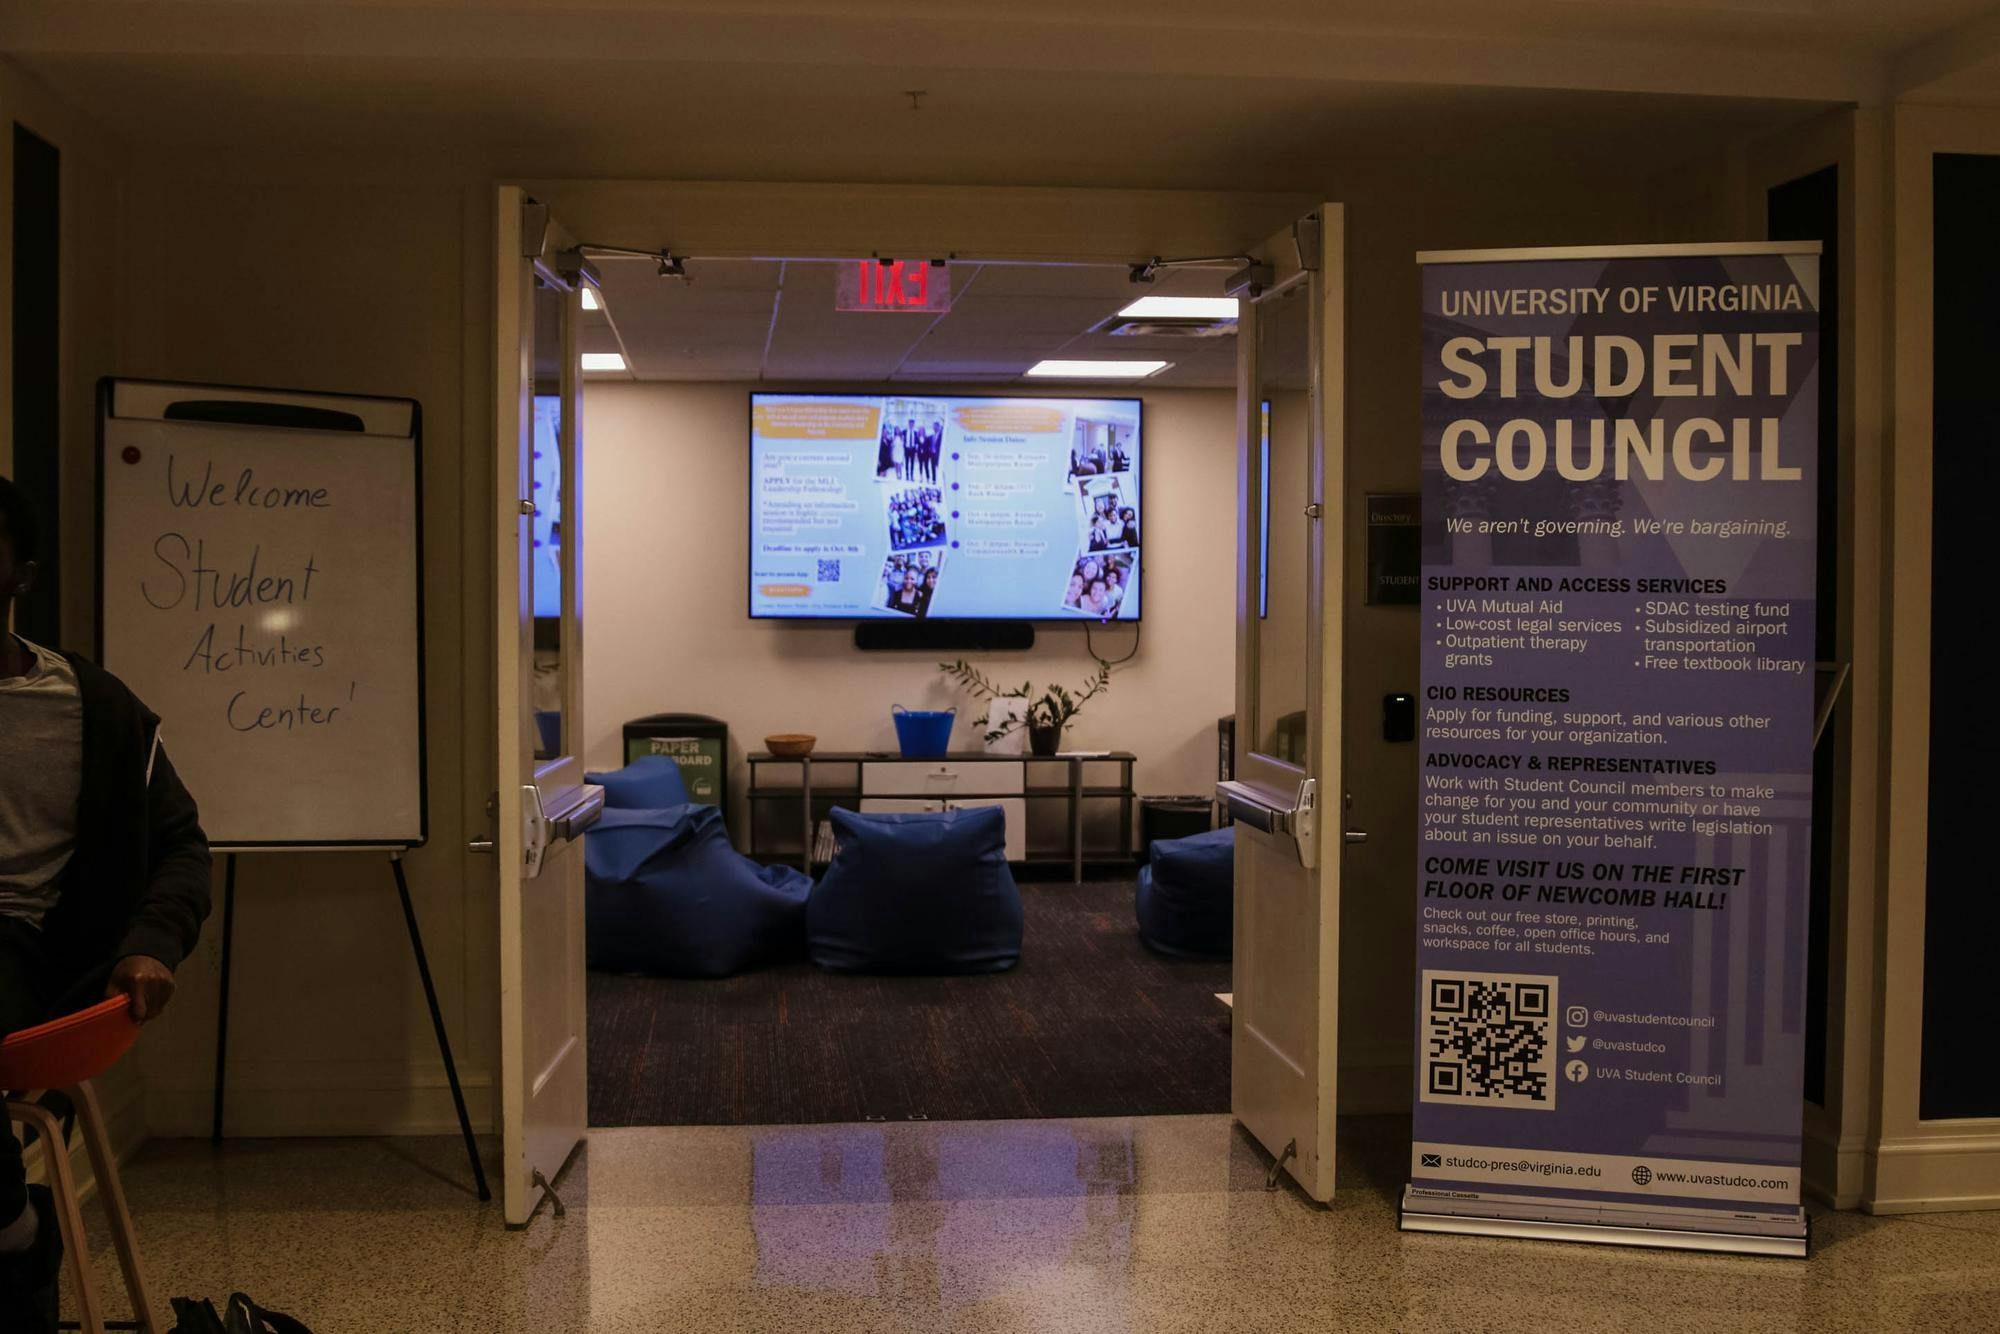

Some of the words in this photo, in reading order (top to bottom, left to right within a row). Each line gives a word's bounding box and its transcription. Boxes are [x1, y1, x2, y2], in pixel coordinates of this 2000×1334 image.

[1441, 287, 1610, 316] UNIVERSITY
[1619, 286, 1659, 313] OF
[1667, 283, 1804, 312] VIRGINIA
[1438, 333, 1802, 398] STUDENT
[1440, 417, 1801, 481] COUNCIL
[167, 453, 330, 507] Welcome
[1446, 517, 1473, 533] We
[1478, 518, 1530, 533] aren't
[1534, 518, 1625, 537] governing.
[1634, 518, 1683, 534] We're
[1690, 519, 1789, 538] bargaining.
[141, 532, 320, 611] Student
[1427, 576, 1510, 591] SUPPORT
[1515, 577, 1553, 592] AND
[1558, 577, 1630, 592] ACCESS
[1636, 578, 1726, 594] SERVICES
[1446, 599, 1476, 612] UVA
[1482, 599, 1533, 613] Mutual
[1538, 599, 1562, 613] Aid
[1645, 601, 1689, 615] SDAC
[1694, 602, 1749, 619] testing
[1754, 602, 1789, 616] fund
[1446, 617, 1511, 631] Low-cost
[1517, 617, 1552, 634] legal
[1558, 618, 1621, 632] services
[1645, 619, 1730, 634] Subsidized
[1736, 620, 1788, 637] airport
[184, 624, 325, 674] Activities
[1445, 634, 1525, 650] Outpatient
[1529, 635, 1587, 652] therapy
[1644, 638, 1755, 654] transportation
[1445, 653, 1493, 668] grants
[1645, 655, 1678, 669] Free
[1683, 656, 1751, 670] textbook
[1757, 657, 1805, 674] library
[1426, 685, 1456, 700] CIO
[1463, 686, 1569, 703] RESOURCES
[1426, 707, 1466, 724] Apply
[1471, 708, 1491, 721] for
[1496, 708, 1557, 726] funding,
[1563, 712, 1626, 726] support,
[1632, 712, 1661, 726] and
[1666, 712, 1723, 727] various
[1729, 714, 1771, 728] other
[1426, 727, 1500, 739] resources
[1505, 727, 1527, 740] for
[1531, 729, 1564, 743] your
[1569, 728, 1667, 745] organization.
[650, 741, 700, 754] PAPER
[672, 755, 713, 766] BOARD
[1425, 752, 1522, 769] ADVOCACY
[1527, 755, 1541, 770] &
[1547, 756, 1716, 775] REPRESENTATIVES
[1425, 775, 1463, 789] Work
[1467, 776, 1498, 790] with
[1504, 777, 1564, 792] Student
[1568, 779, 1625, 794] Council
[1631, 782, 1704, 797] members
[1709, 783, 1725, 797] to
[1731, 784, 1774, 799] make
[1425, 792, 1479, 810] change
[1484, 794, 1505, 808] for
[1509, 798, 1535, 811] you
[1541, 797, 1569, 810] and
[1574, 800, 1608, 813] your
[1612, 800, 1697, 817] community
[1702, 804, 1718, 815] or
[1723, 802, 1760, 816] have
[1424, 812, 1456, 826] your
[1462, 811, 1519, 826] student
[1524, 816, 1643, 830] representatives
[1649, 818, 1686, 832] write
[1692, 819, 1772, 835] legislation
[1424, 827, 1467, 842] about
[1472, 831, 1491, 842] an
[1496, 829, 1537, 844] issue
[1542, 834, 1561, 845] on
[1566, 835, 1599, 848] your
[1604, 833, 1656, 848] behalf.
[1424, 856, 1490, 876] COME
[1496, 859, 1550, 878] VISIT
[1556, 861, 1584, 880] US
[1592, 863, 1624, 881] ON
[1631, 864, 1674, 883] THE
[1679, 866, 1746, 886] FIRST
[1424, 880, 1494, 900] FLOOR
[1502, 883, 1531, 901] OF
[1536, 885, 1656, 907] NEWCOMB
[1663, 890, 1726, 910] HALL!
[1423, 906, 1462, 919] Check
[1466, 910, 1486, 920] out
[1490, 912, 1511, 921] our
[1515, 910, 1540, 923] free
[1544, 913, 1581, 926] store,
[1586, 914, 1638, 930] printing,
[1423, 922, 1471, 935] snacks,
[1476, 924, 1519, 937] coffee,
[1524, 928, 1556, 940] open
[1560, 927, 1595, 940] office
[1600, 929, 1640, 943] hours,
[1645, 932, 1669, 943] and
[1422, 937, 1490, 951] workspace
[1494, 939, 1511, 951] for
[1514, 941, 1529, 951] all
[1534, 942, 1594, 955] students.
[1593, 1010, 1714, 1027] @uvastudentcouncil
[1592, 1038, 1666, 1053] @uvastudco
[1596, 1067, 1620, 1079] UVA
[1624, 1069, 1672, 1083] Student
[1676, 1072, 1721, 1085] Council
[1446, 1156, 1601, 1176] studco-pres@virginia.edu
[1656, 1172, 1788, 1189] www.uvastudco.com
